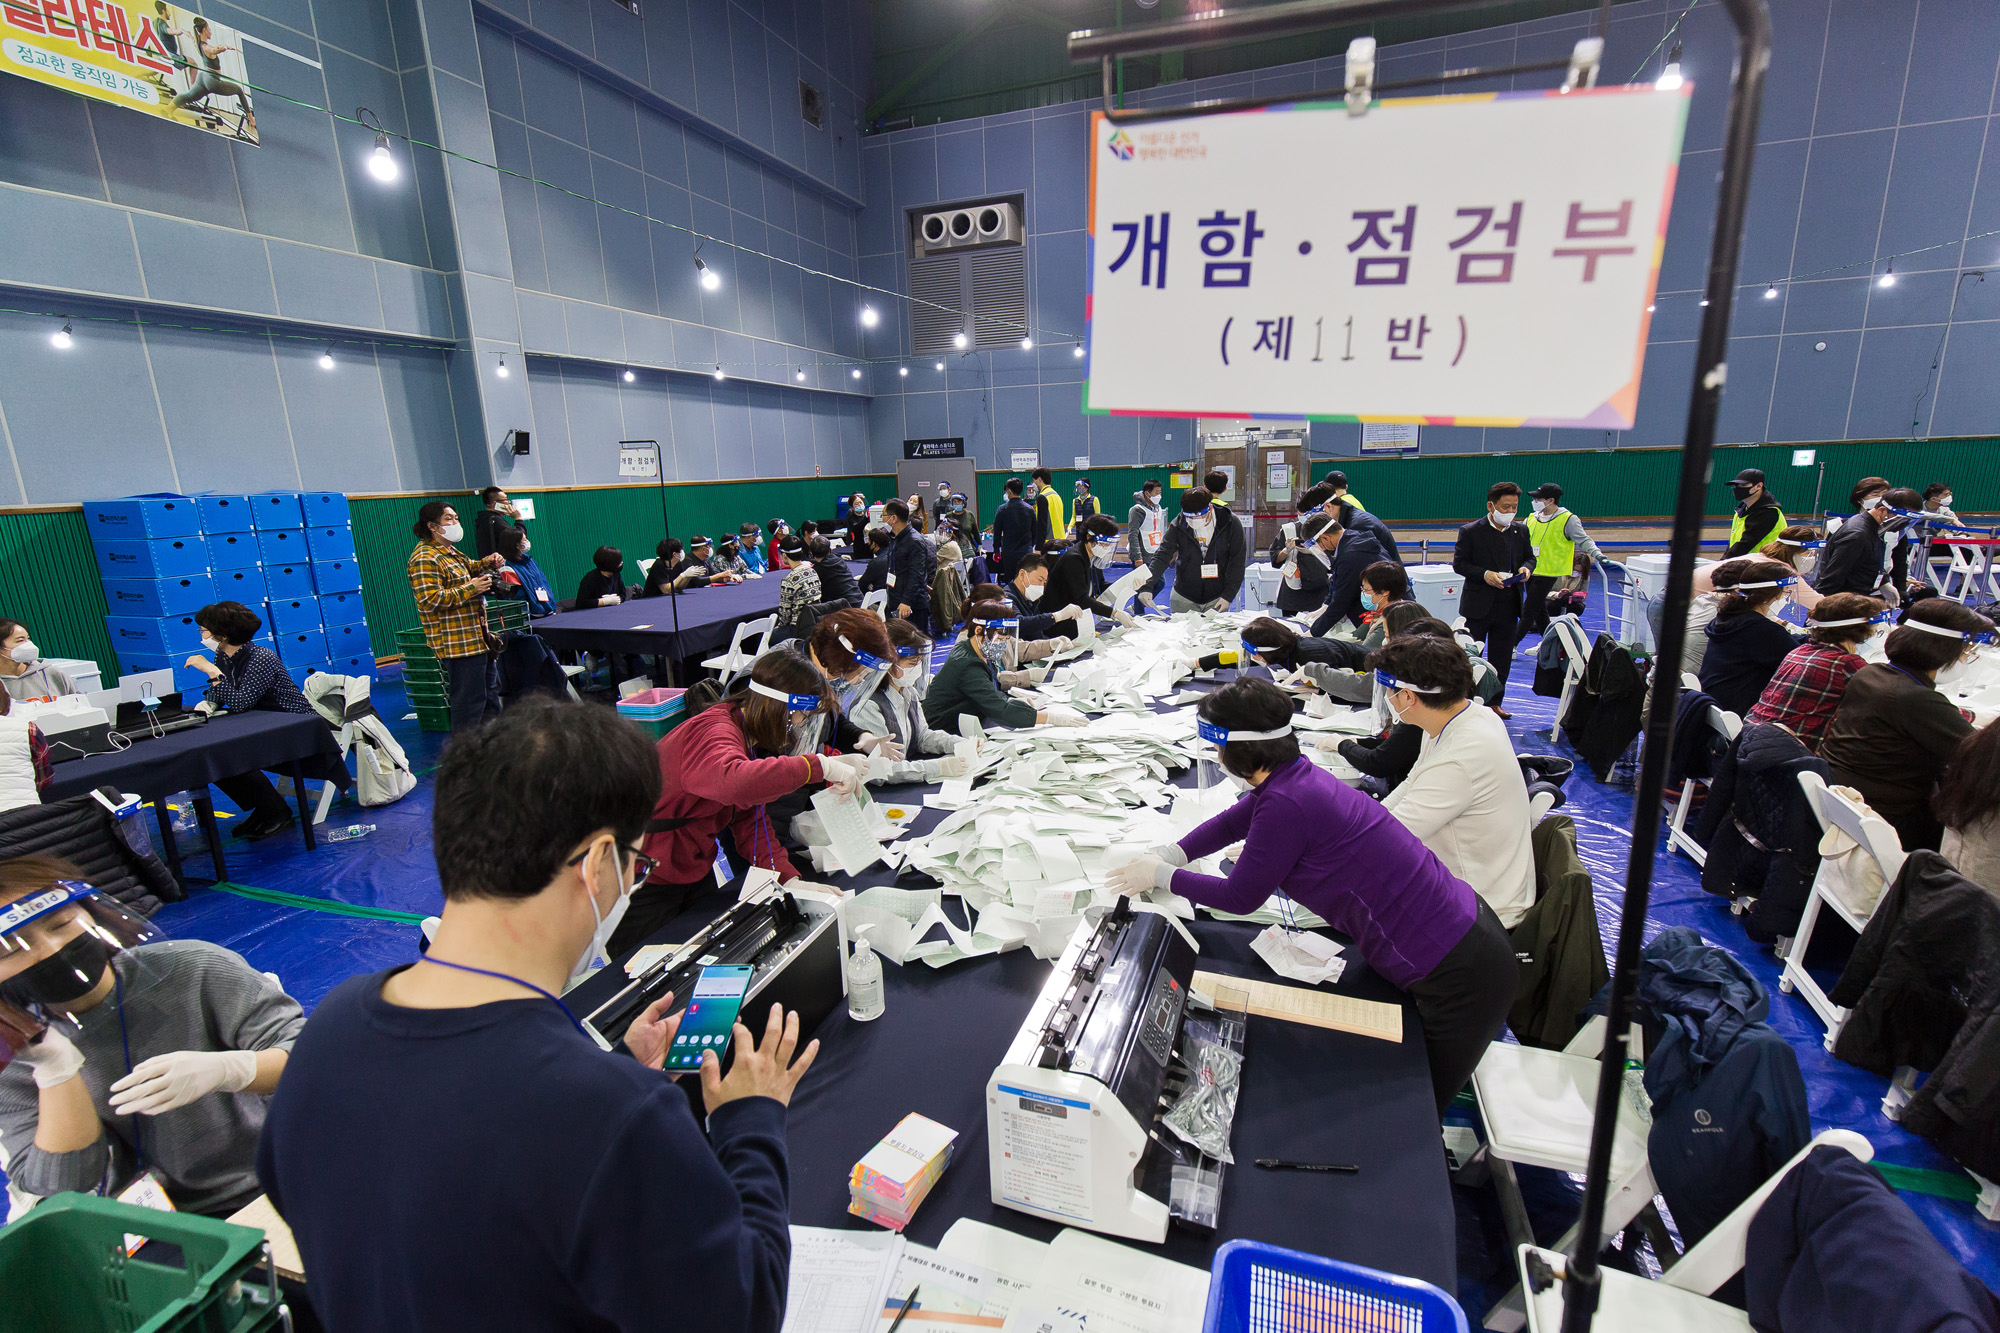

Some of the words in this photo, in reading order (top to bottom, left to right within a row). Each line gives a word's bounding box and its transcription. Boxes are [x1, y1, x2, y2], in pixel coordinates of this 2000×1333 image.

[17, 44, 66, 75] 정교한
[71, 62, 117, 90] 움직임
[121, 78, 150, 101] 가능
[907, 1255, 928, 1267] 비례대표
[931, 1262, 947, 1273] 투표지
[949, 1269, 965, 1279] 수개표
[967, 1275, 980, 1284] 방법
[1141, 1298, 1162, 1310] 투표지
